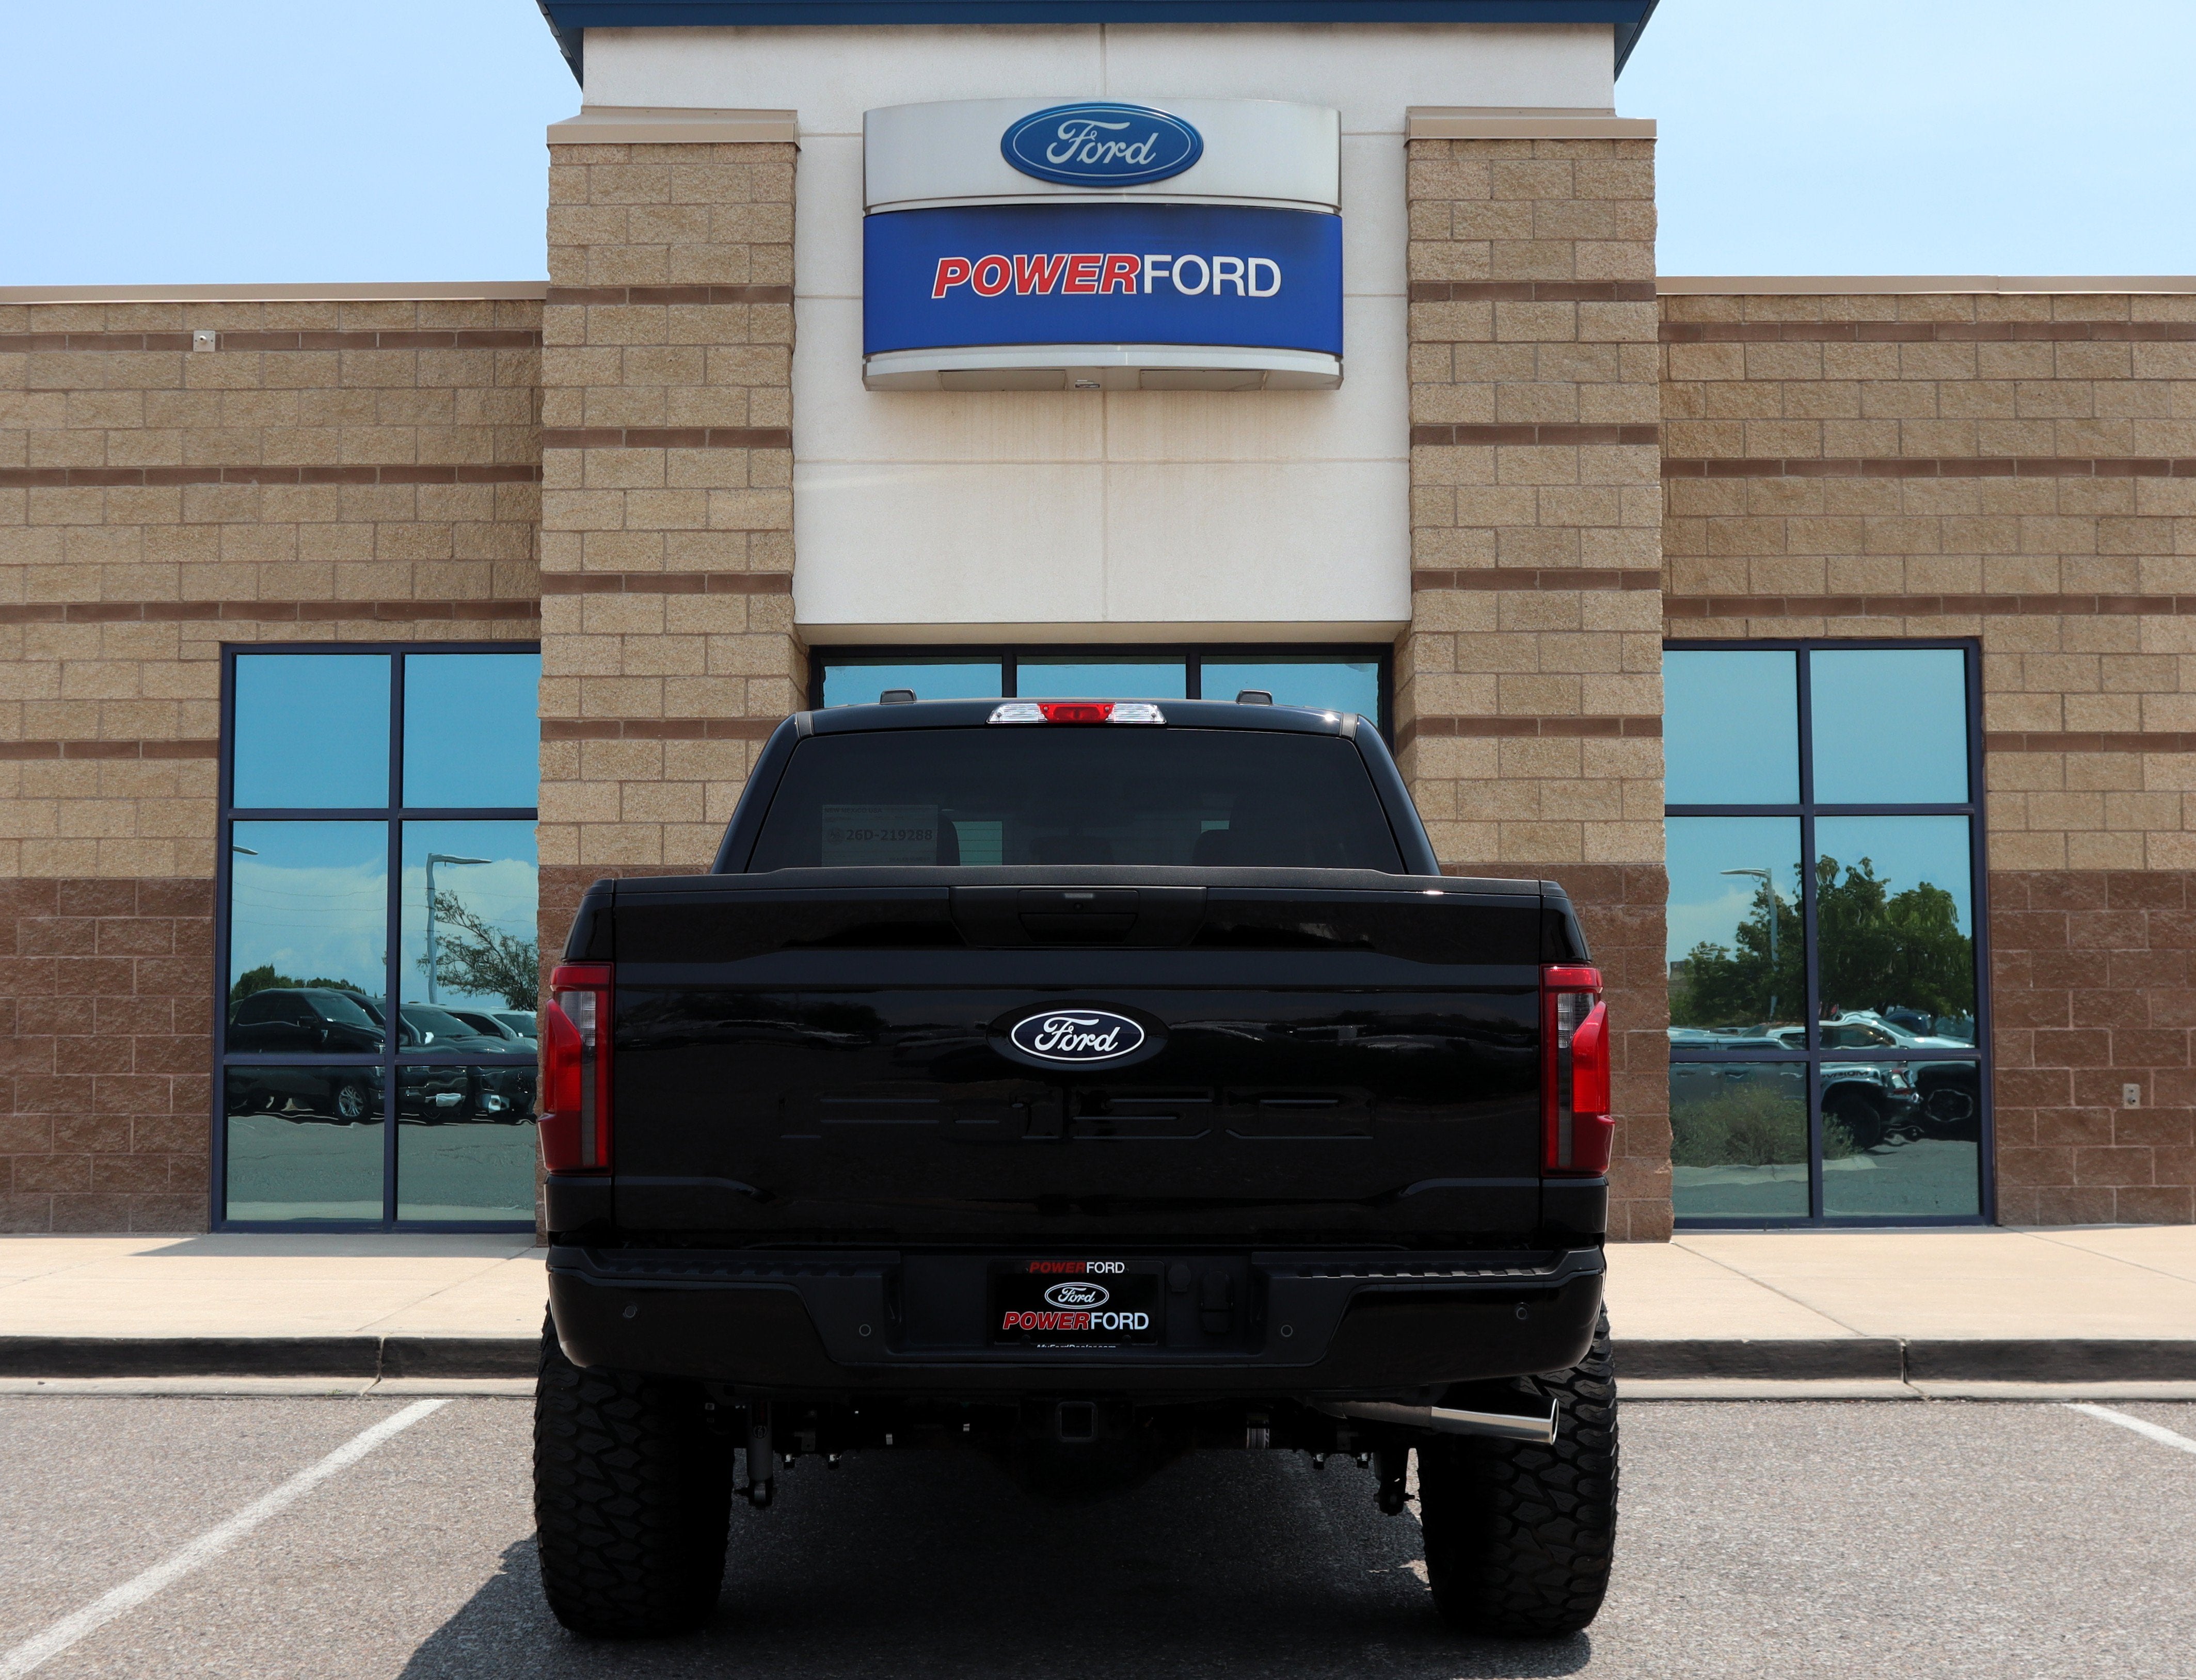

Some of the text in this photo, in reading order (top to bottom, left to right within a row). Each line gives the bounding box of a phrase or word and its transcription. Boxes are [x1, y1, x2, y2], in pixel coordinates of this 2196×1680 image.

[1046, 119, 1159, 165] Ford
[931, 253, 1282, 298] POWERFORD
[846, 829, 933, 841] 26D-219288
[1035, 1017, 1121, 1051] Ford
[1029, 1261, 1125, 1274] POWERFORD
[1058, 1287, 1096, 1303] Ford
[1002, 1311, 1149, 1330] POWERFORD
